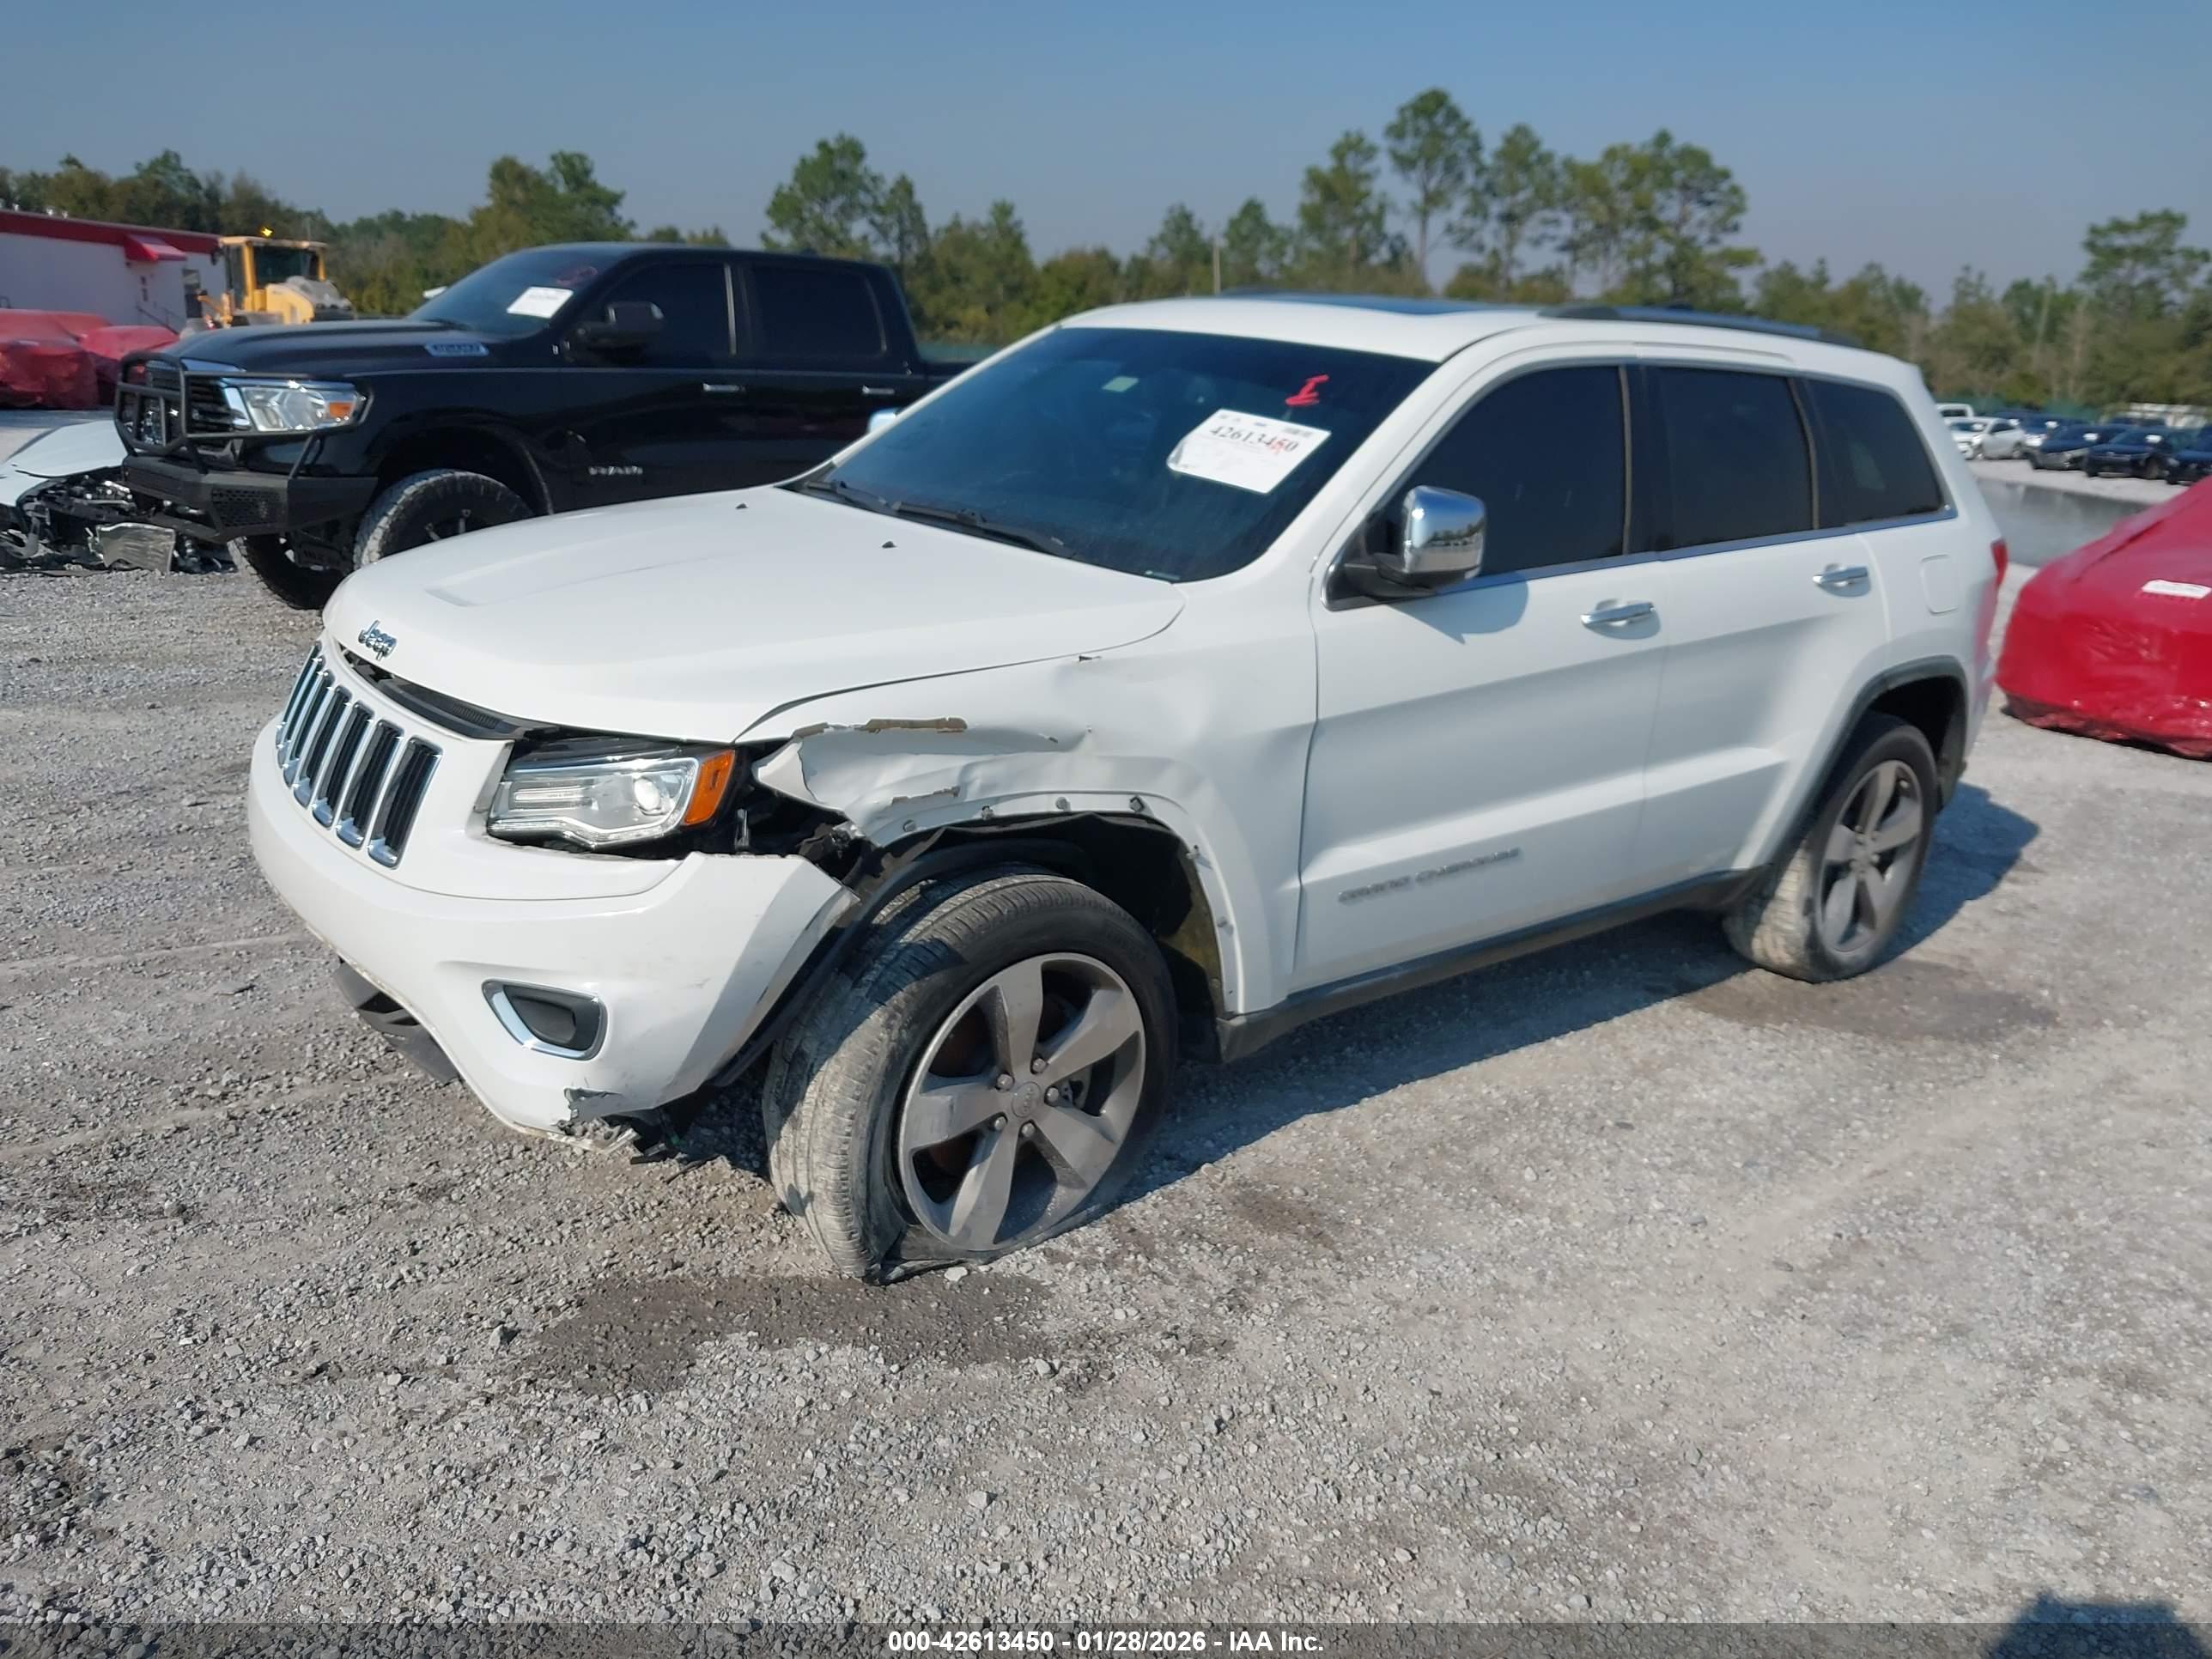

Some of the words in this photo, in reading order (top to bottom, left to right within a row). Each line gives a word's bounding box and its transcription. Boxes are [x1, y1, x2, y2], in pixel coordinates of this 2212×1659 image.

[1209, 425, 1299, 453] 42613450
[588, 465, 644, 477] RAM
[358, 619, 398, 661] Jeep
